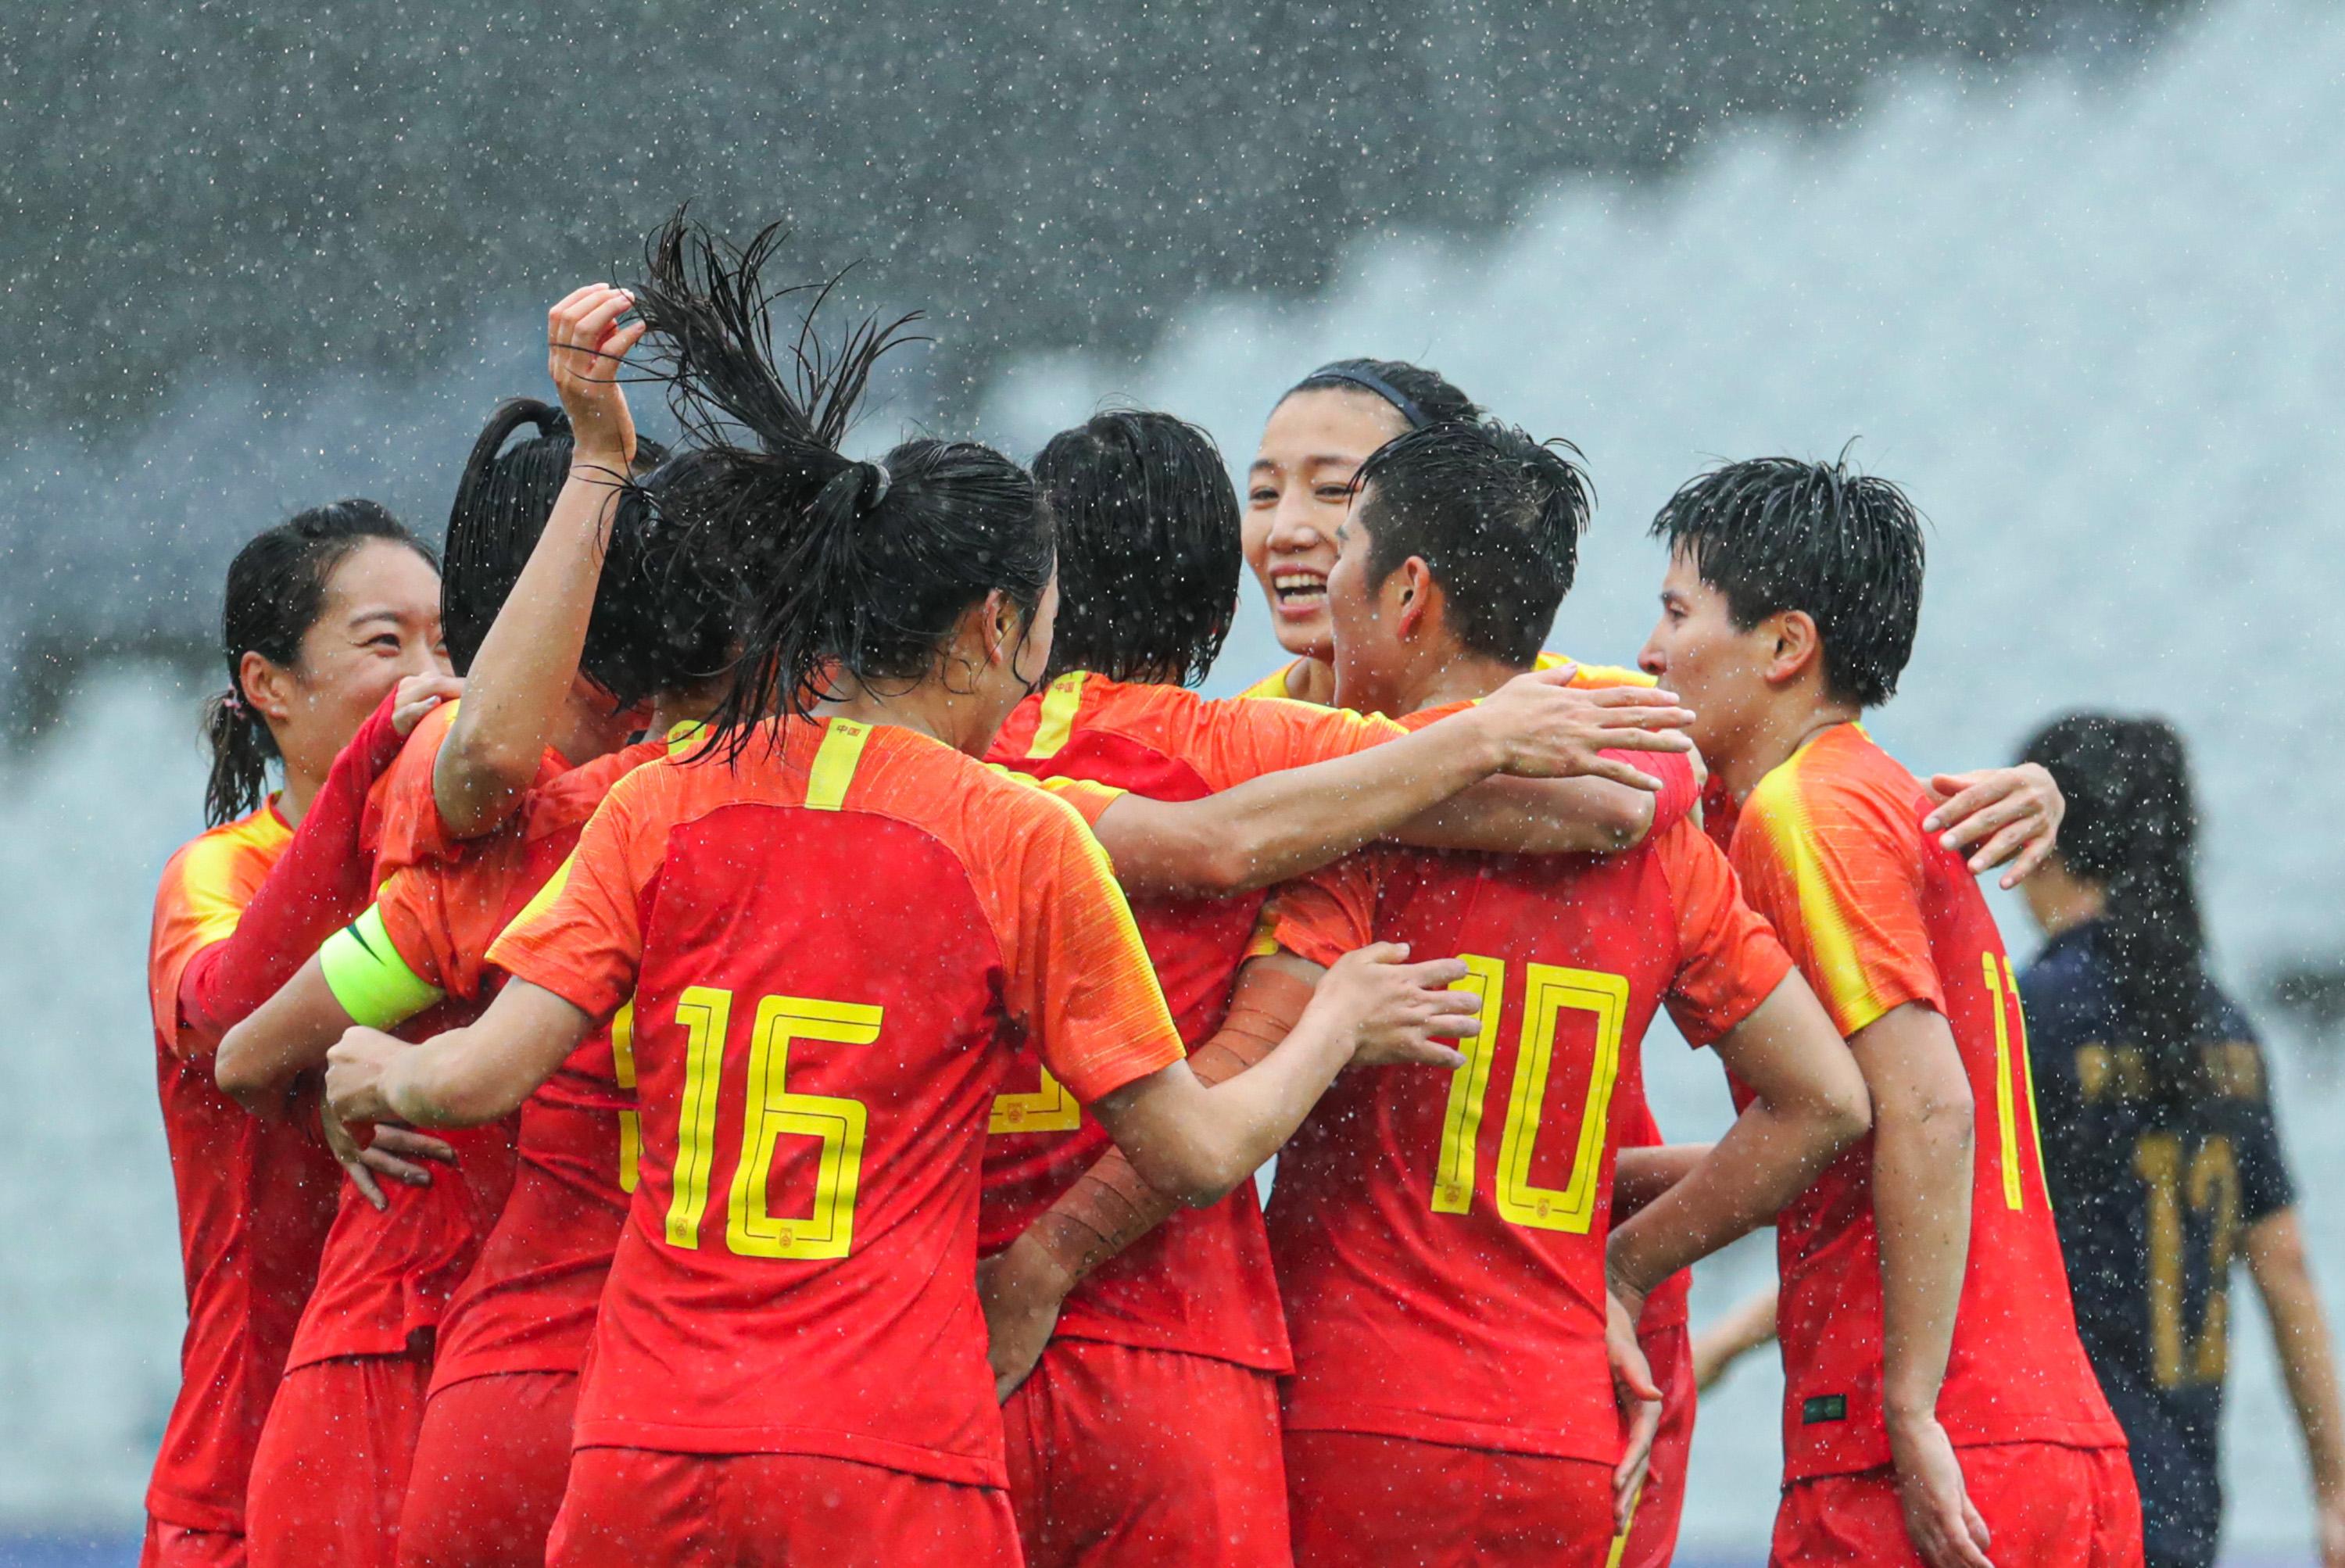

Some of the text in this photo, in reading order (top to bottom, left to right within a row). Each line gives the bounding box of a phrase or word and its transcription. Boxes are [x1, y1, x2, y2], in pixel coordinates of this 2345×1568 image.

[837, 725, 861, 736] 中国
[666, 986, 883, 1259] 16
[1430, 954, 1629, 1234] 10
